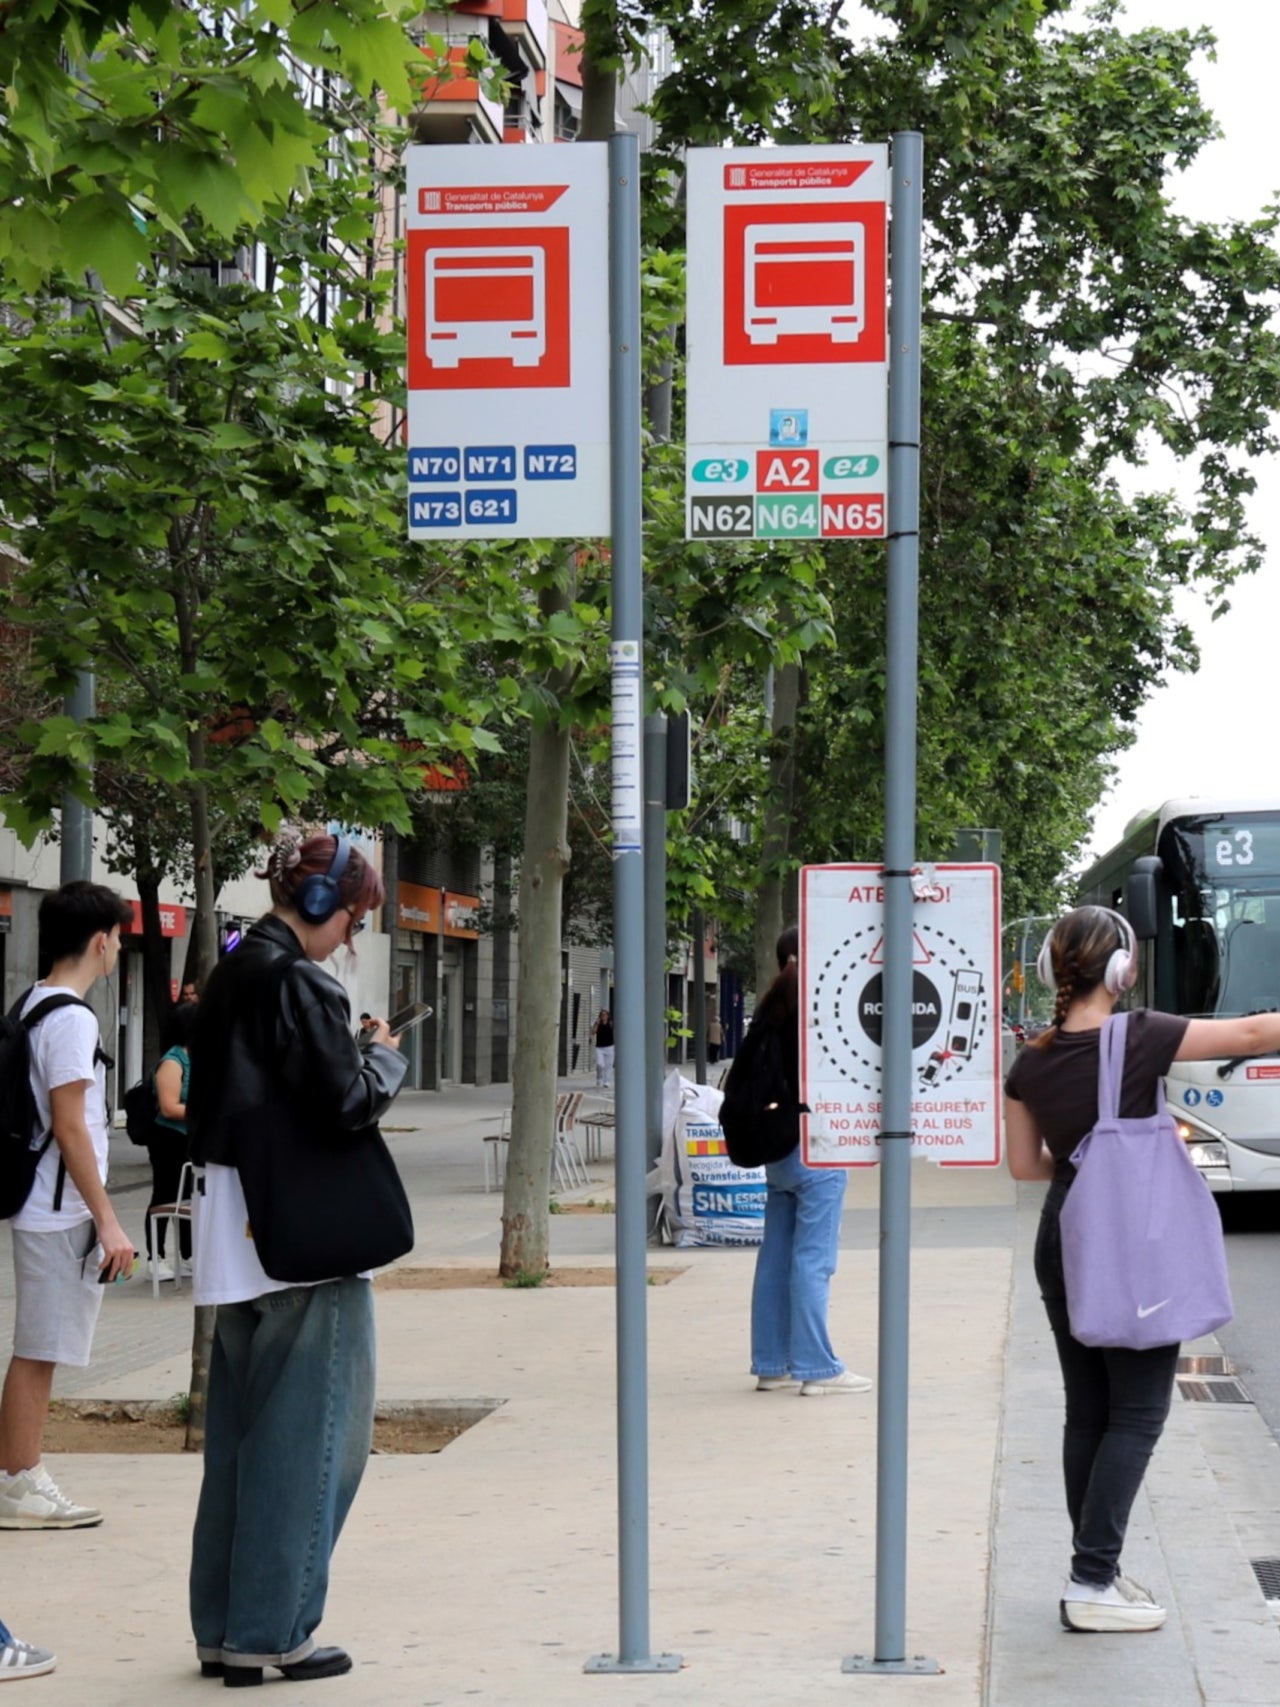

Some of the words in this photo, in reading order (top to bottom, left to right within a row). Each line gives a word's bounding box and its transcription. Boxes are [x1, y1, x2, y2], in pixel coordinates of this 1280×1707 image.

[750, 168, 793, 177] Generalitat
[795, 168, 805, 177] de
[807, 167, 848, 177] Catalunya
[750, 178, 797, 188] Transports
[799, 177, 831, 187] públics
[445, 192, 489, 201] Generalitat
[490, 192, 501, 201] de
[503, 191, 544, 201] Catalunya
[445, 202, 493, 212] Transports
[495, 201, 528, 211] públics
[413, 457, 458, 475] N70
[469, 456, 512, 474] N71
[529, 455, 574, 473] N72
[705, 459, 739, 482] e3
[764, 457, 810, 487] A2
[833, 457, 869, 477] e4
[414, 502, 460, 520] N73
[470, 500, 510, 517] 621
[693, 505, 751, 531] N62
[758, 504, 816, 530] N64
[823, 504, 882, 530] N65
[1216, 830, 1254, 866] e3
[957, 983, 978, 994] BUS
[815, 1103, 842, 1114] PER
[846, 1103, 863, 1113] LA
[830, 1119, 849, 1130] NO
[922, 1118, 940, 1129] AL
[943, 1117, 973, 1129] BUS
[838, 1135, 871, 1146] DINS
[695, 1191, 734, 1213] SIN
